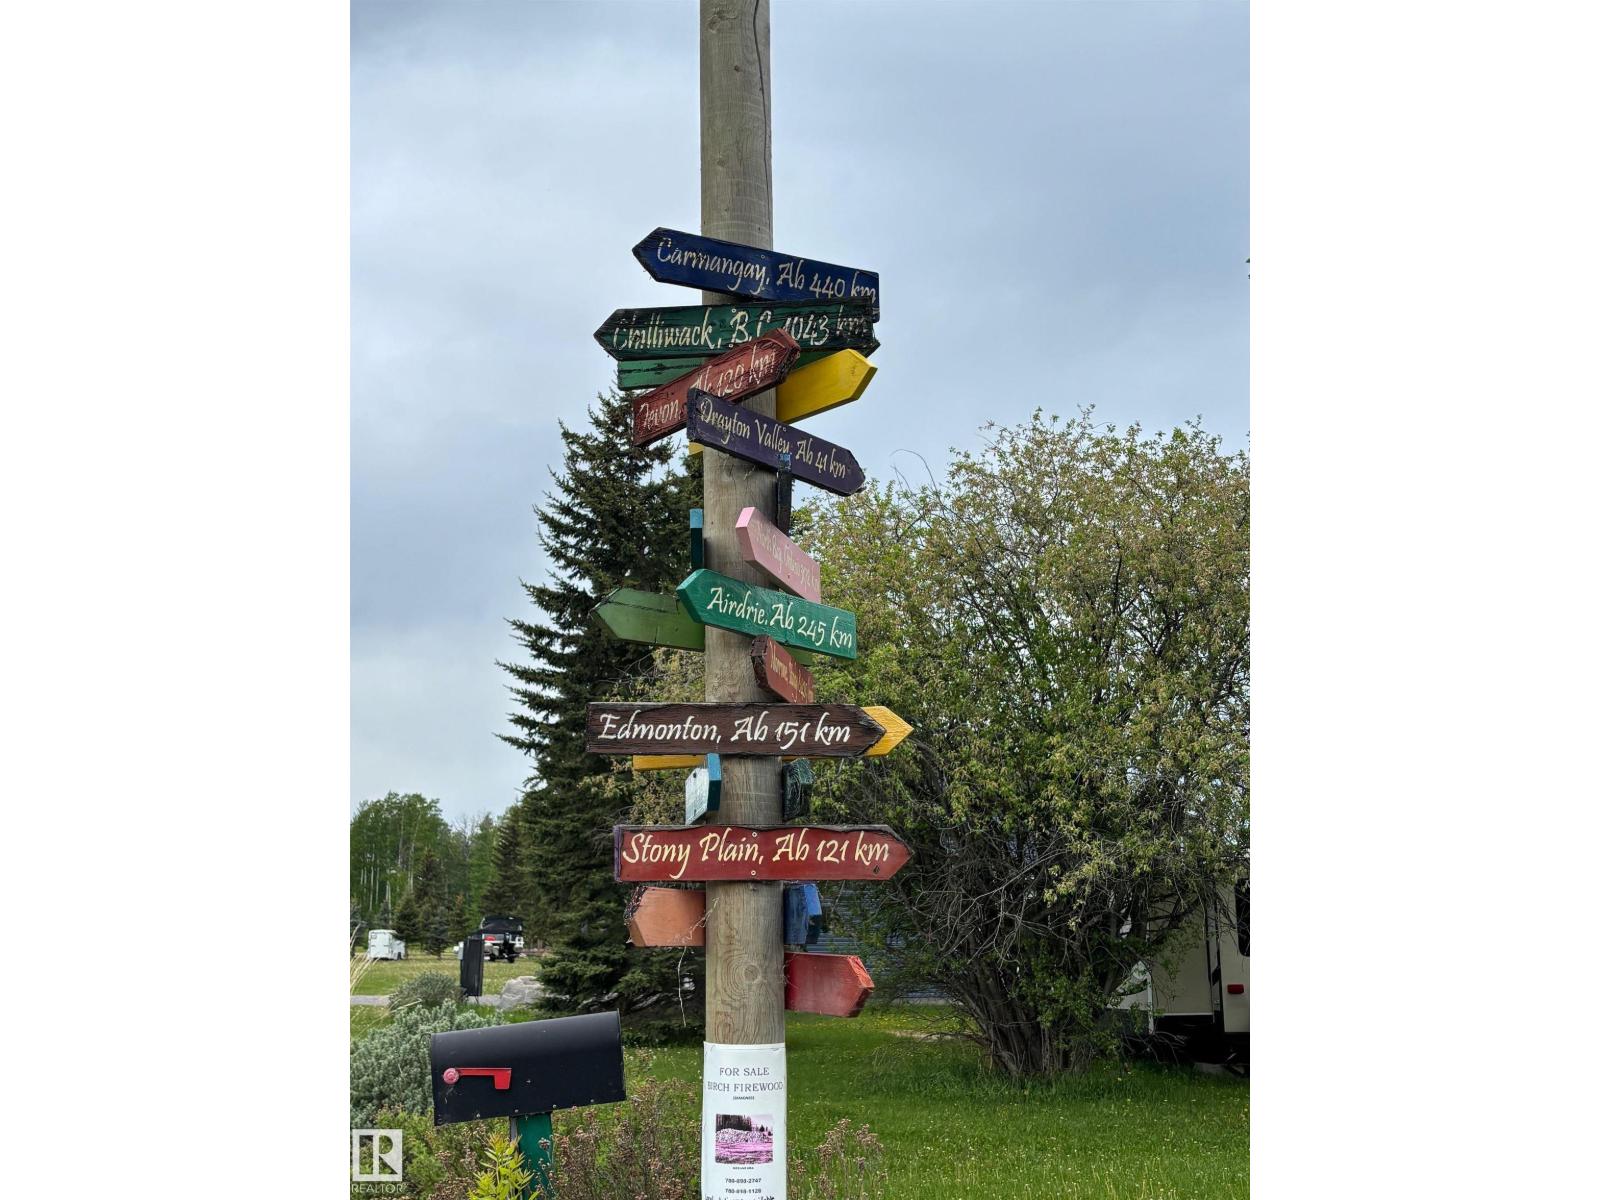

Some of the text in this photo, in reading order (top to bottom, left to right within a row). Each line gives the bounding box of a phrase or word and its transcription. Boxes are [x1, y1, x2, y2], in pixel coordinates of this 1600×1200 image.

[657, 238, 876, 303] Carmangay, Ab 440 km
[613, 308, 721, 349] Chilliwack,
[699, 398, 751, 444] Drayton
[796, 439, 814, 467] Ab
[829, 451, 847, 479] km
[769, 601, 795, 631] Ab
[796, 616, 827, 647] 245
[829, 615, 853, 650] km
[597, 710, 852, 750] Edmonton, Ab 151 km
[622, 827, 890, 880] Stony Plain, Ab 121 km
[719, 1066, 770, 1077] FOR SALE
[733, 1081, 784, 1093] FIREWOOD
